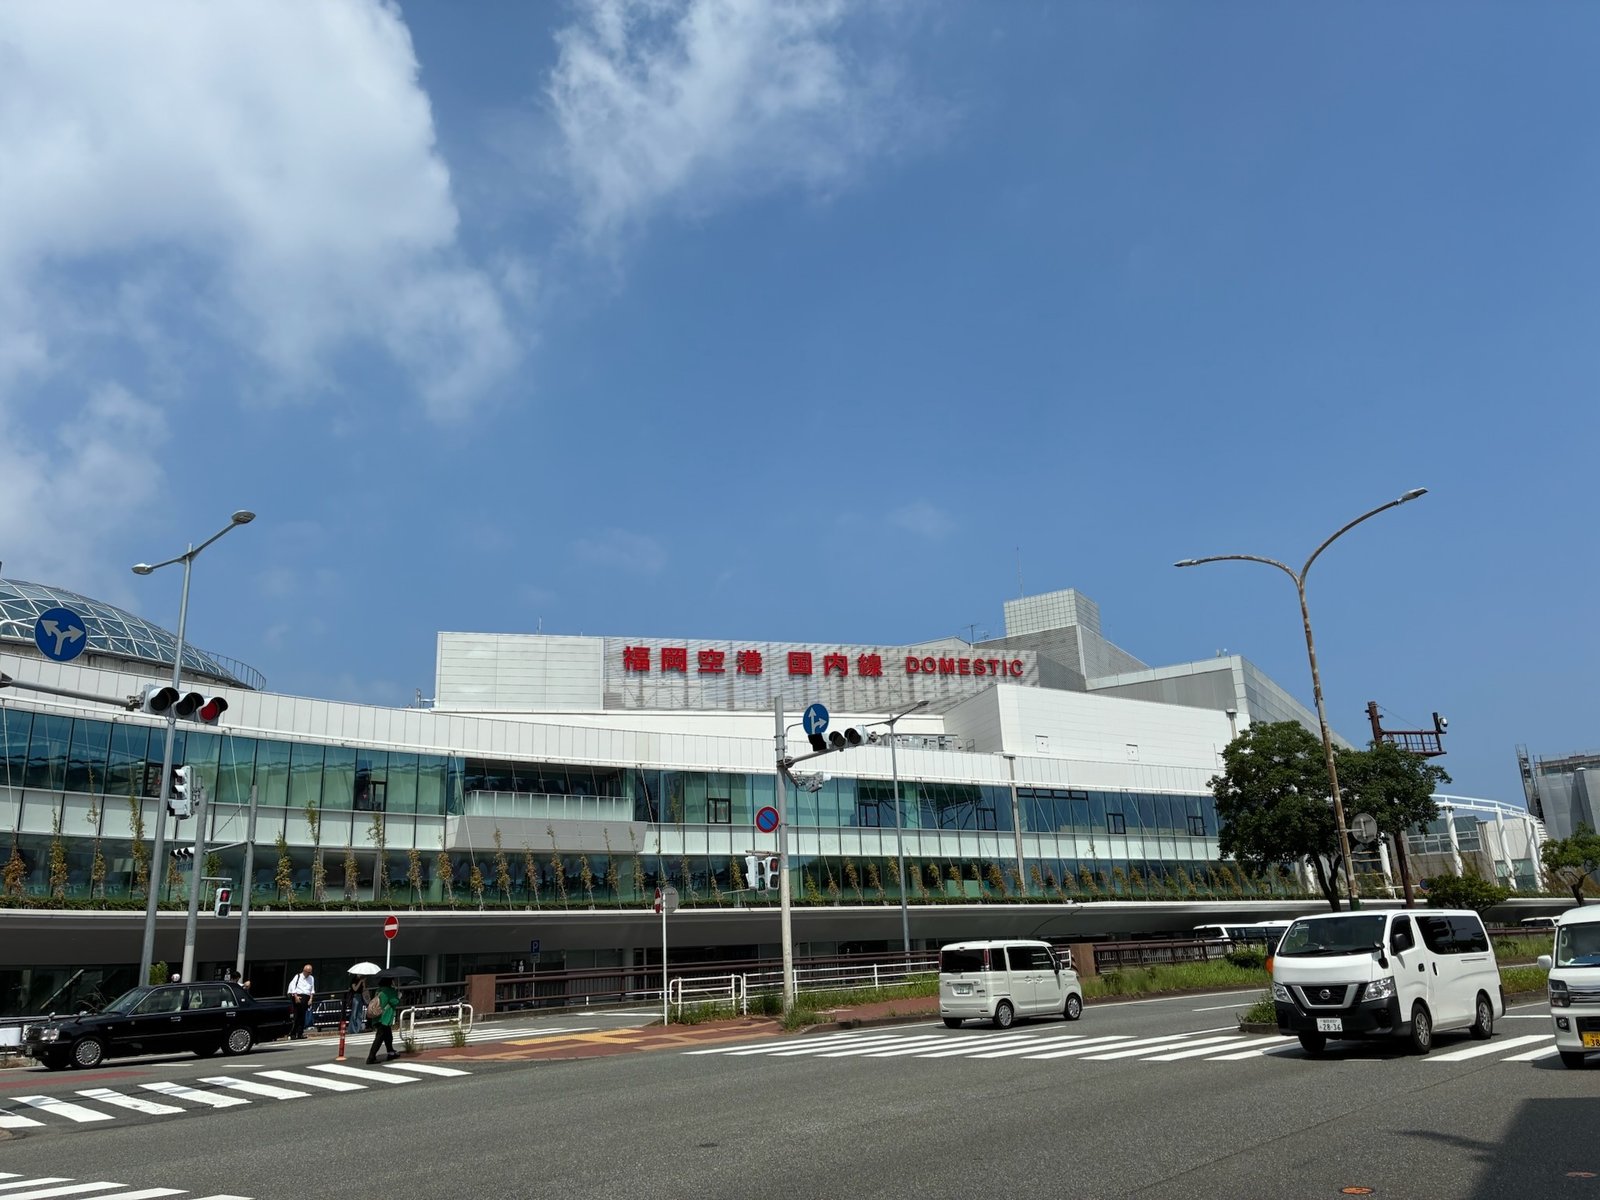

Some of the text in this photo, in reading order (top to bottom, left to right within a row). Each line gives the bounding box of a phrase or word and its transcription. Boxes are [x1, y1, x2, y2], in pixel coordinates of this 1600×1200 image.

[623, 646, 1024, 677] 福岡空港 国内線 DOMESTIC
